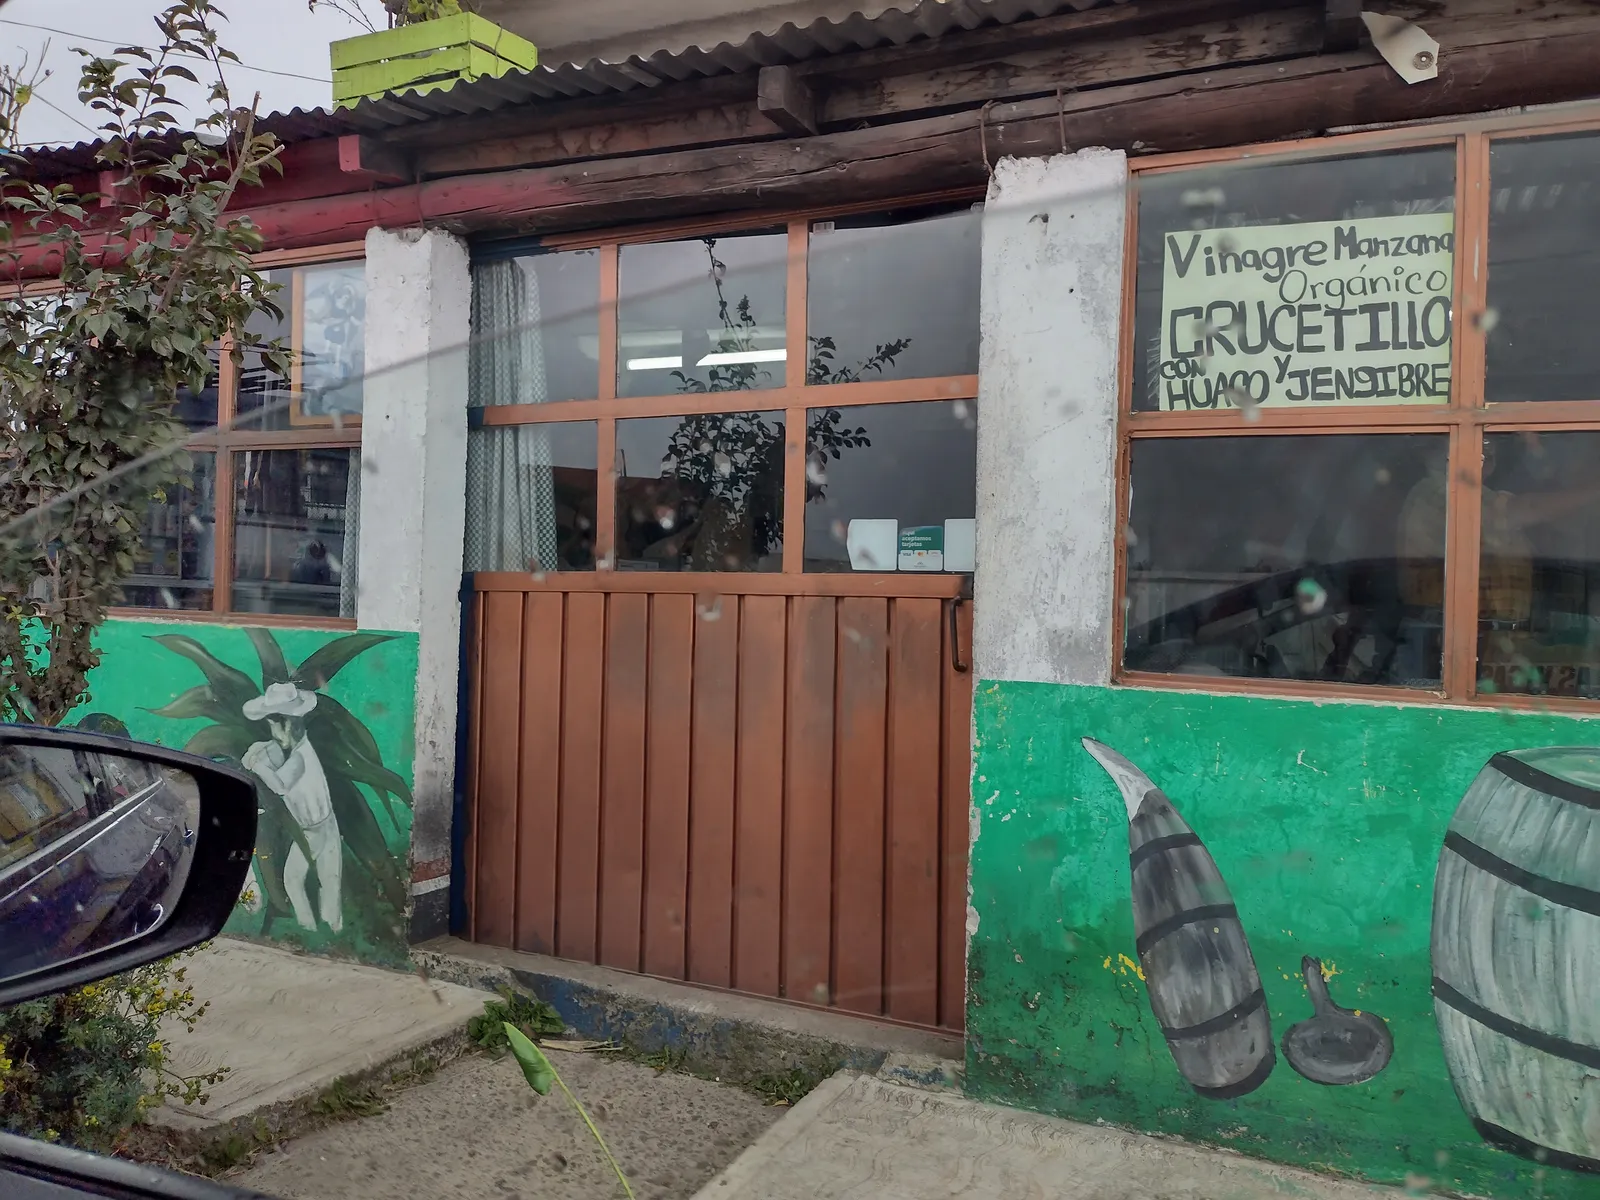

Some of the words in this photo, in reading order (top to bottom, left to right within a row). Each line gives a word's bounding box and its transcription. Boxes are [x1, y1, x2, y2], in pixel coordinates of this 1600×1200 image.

[1167, 234, 1328, 284] Vinagre
[1334, 225, 1454, 261] Manzana
[1279, 264, 1448, 311] Orgánico
[1170, 296, 1451, 359] CRUCETILLO
[1160, 357, 1206, 379] CON
